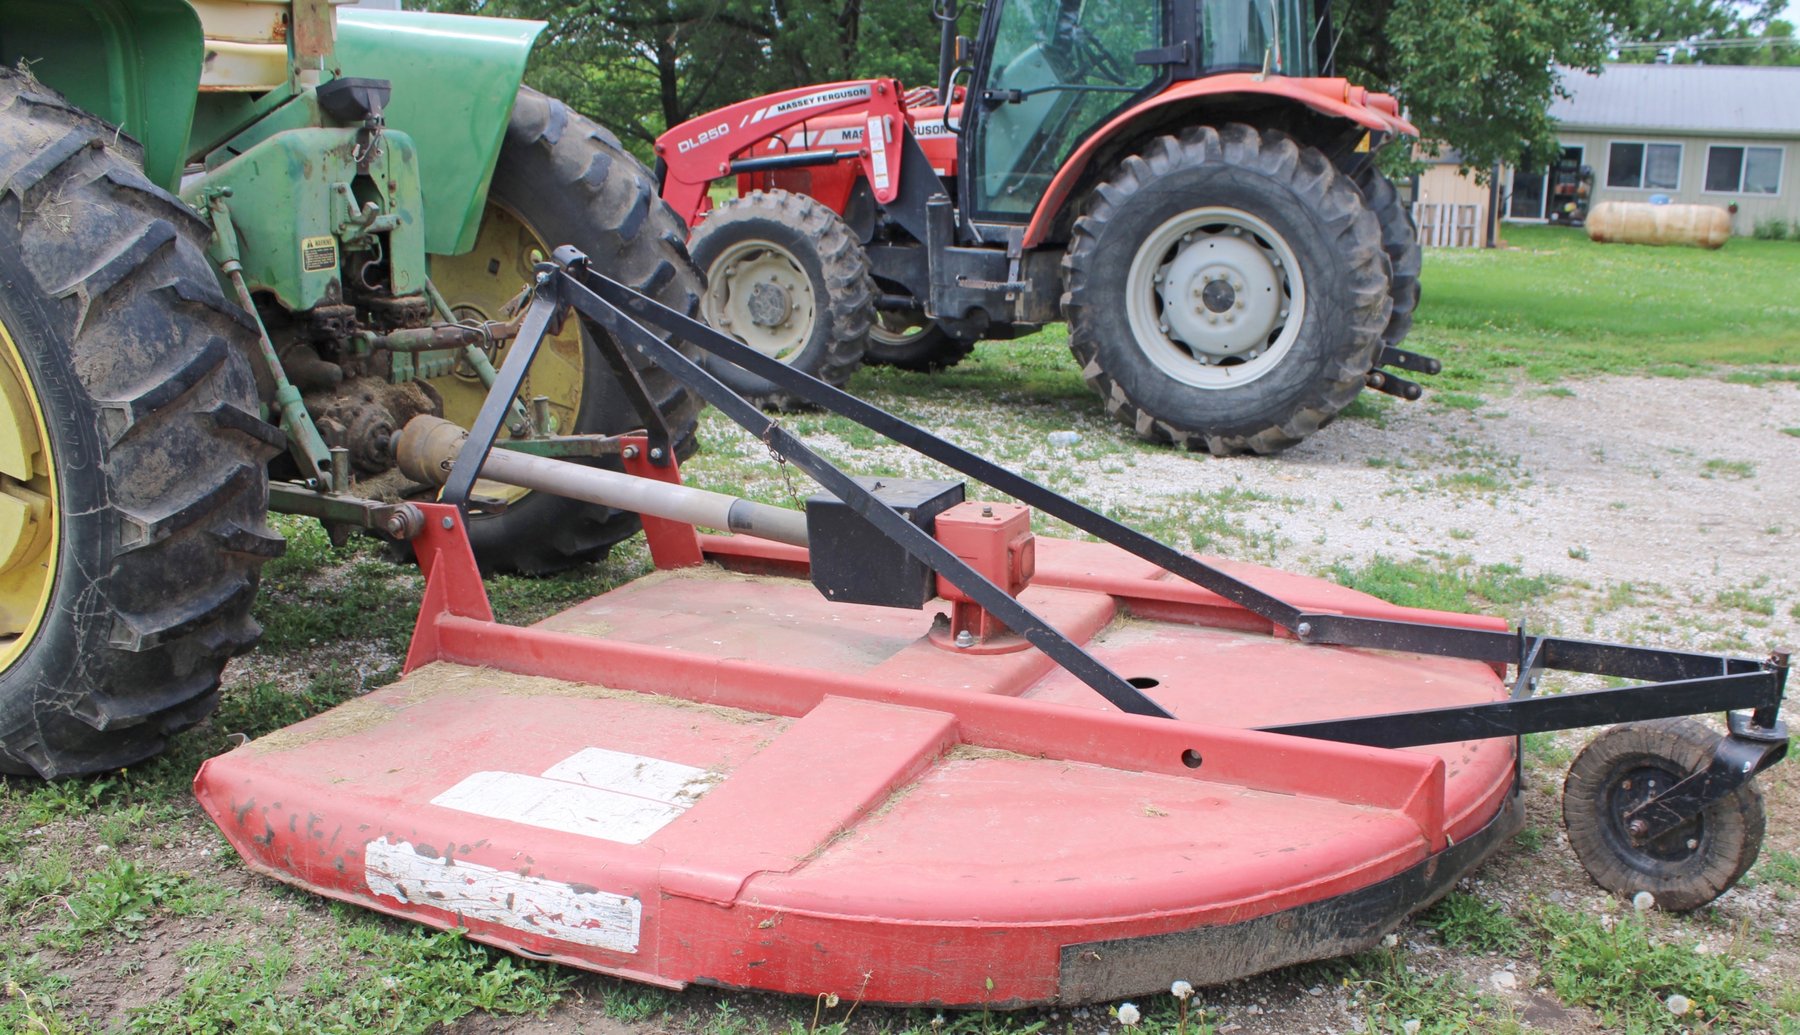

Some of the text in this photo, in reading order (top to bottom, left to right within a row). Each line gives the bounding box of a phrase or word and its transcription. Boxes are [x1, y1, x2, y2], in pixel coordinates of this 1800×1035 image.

[777, 88, 867, 112] MASSEY FERGUSON
[677, 123, 730, 153] DL250
